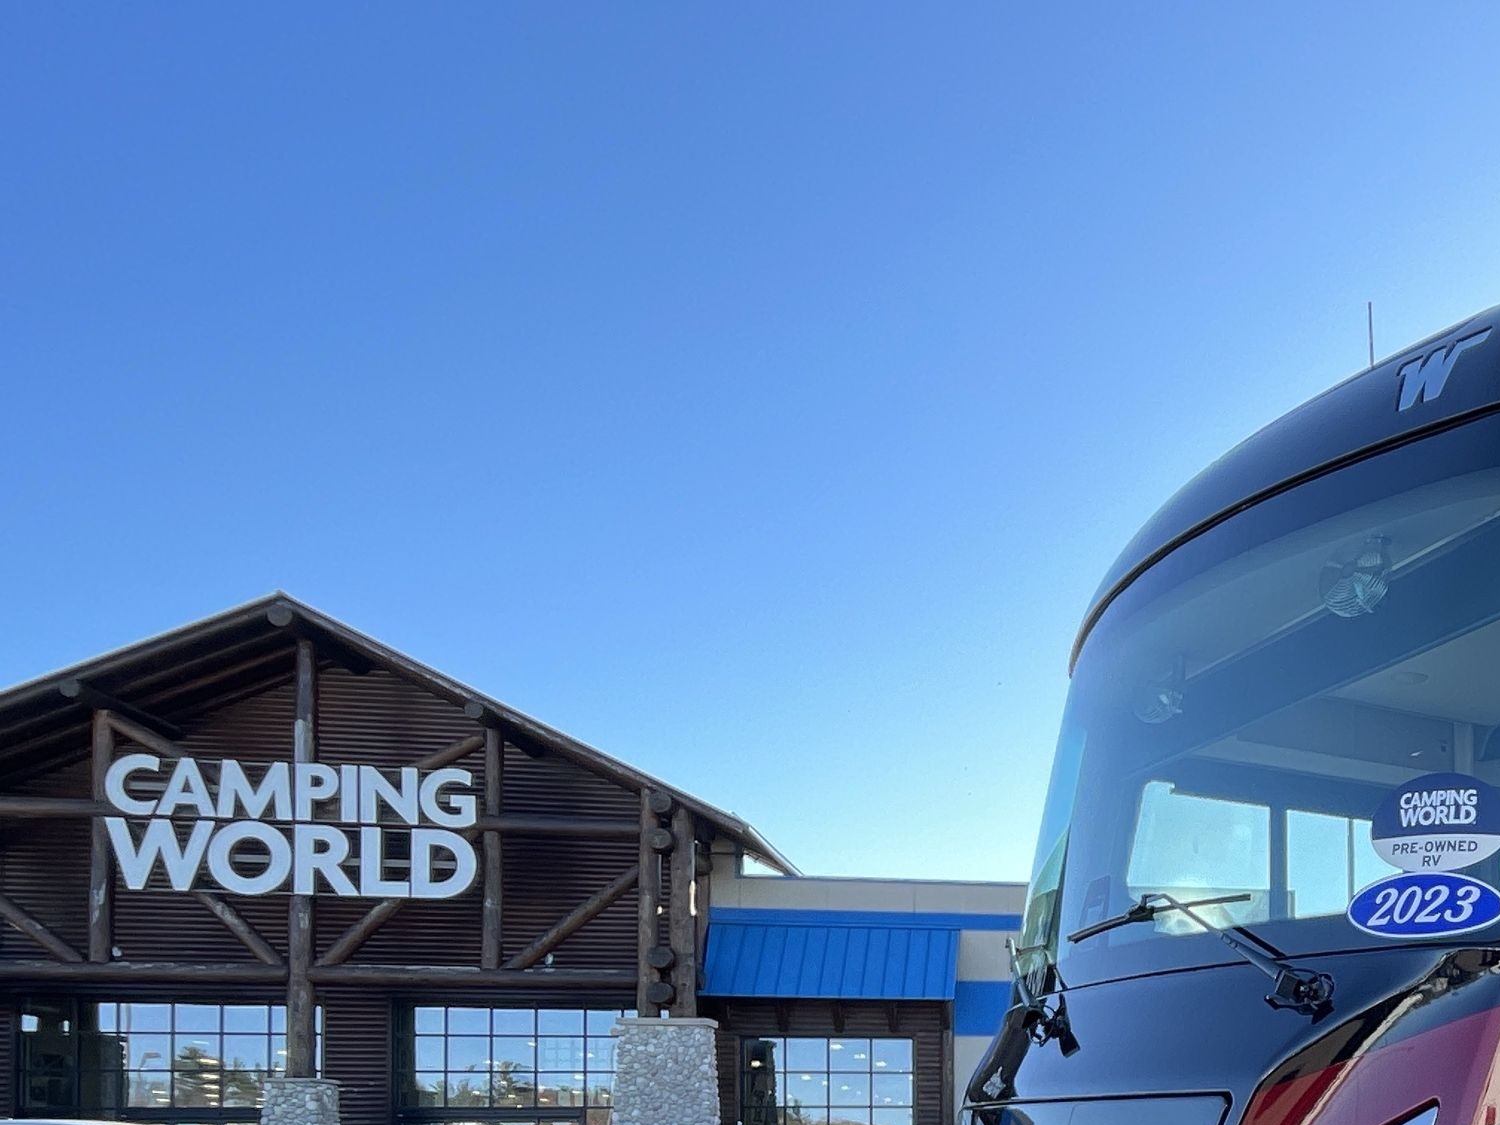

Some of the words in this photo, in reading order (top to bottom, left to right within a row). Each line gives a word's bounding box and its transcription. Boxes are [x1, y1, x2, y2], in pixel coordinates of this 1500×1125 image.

[104, 753, 477, 828] CAMPING
[1400, 789, 1477, 809] CAMPING
[1400, 805, 1477, 827] WORLD
[104, 816, 478, 899] WORLD
[1392, 841, 1478, 855] PRE-OWNED
[1422, 855, 1441, 867] RV
[1366, 884, 1481, 927] 2023
